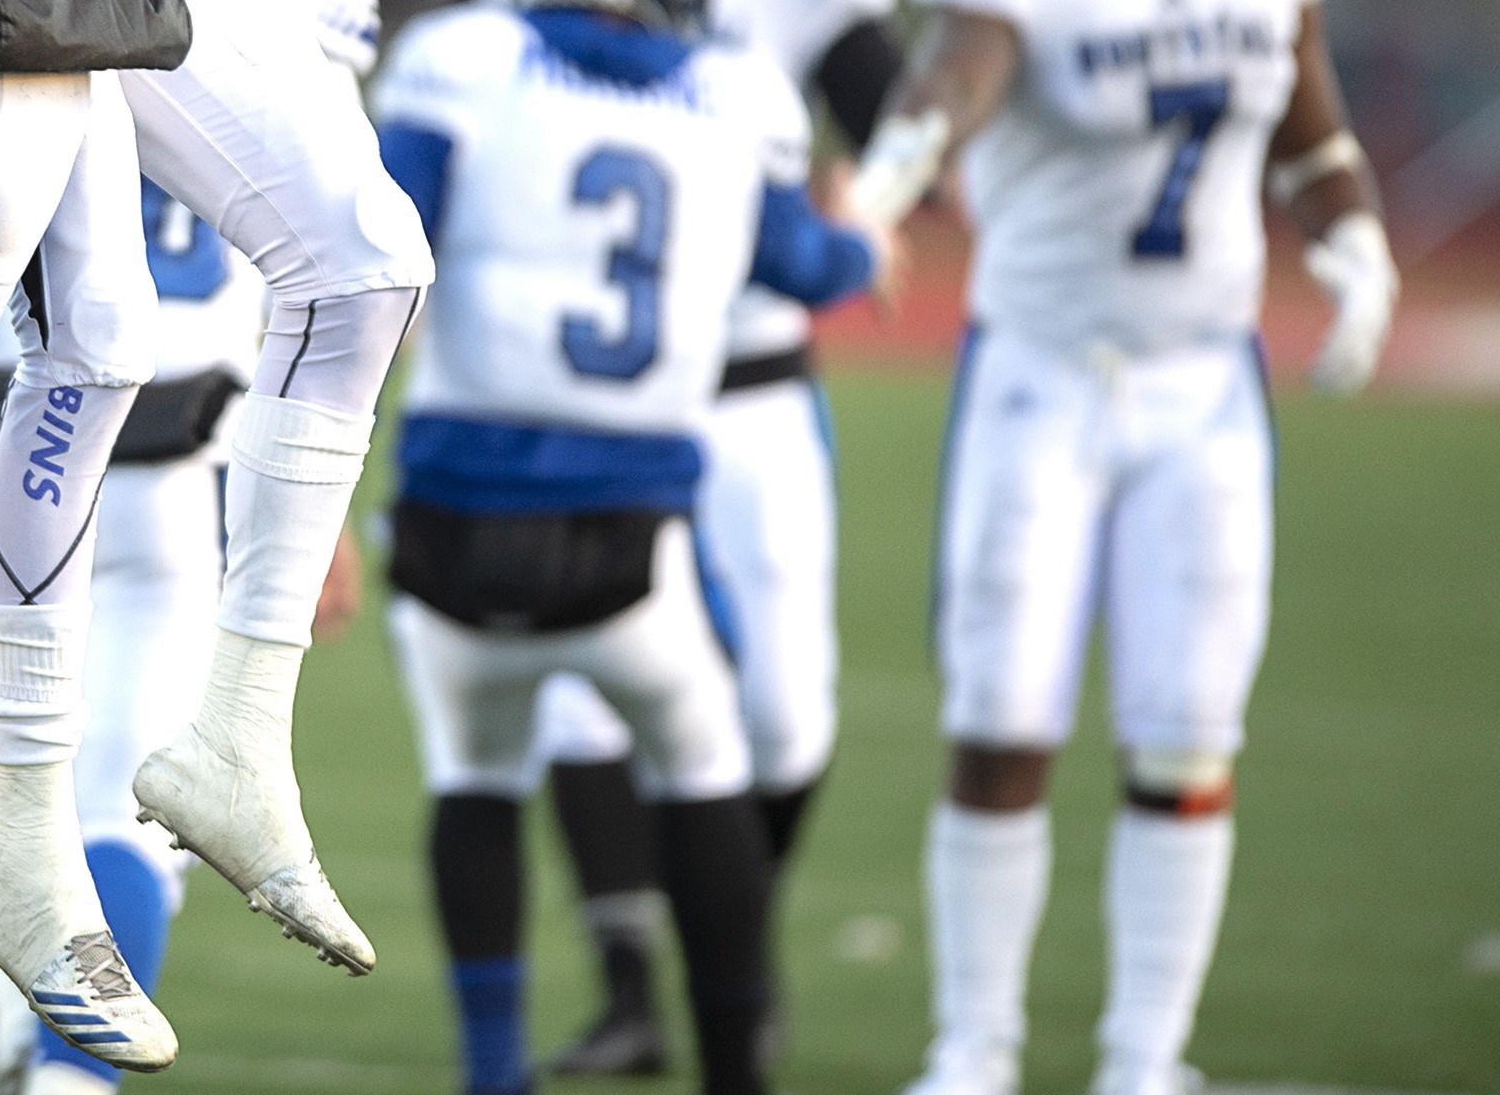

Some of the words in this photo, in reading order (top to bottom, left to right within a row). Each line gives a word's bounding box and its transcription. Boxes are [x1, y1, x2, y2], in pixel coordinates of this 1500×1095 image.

[1132, 75, 1228, 258] 7
[560, 143, 673, 383] 3
[22, 385, 84, 507] BINS
